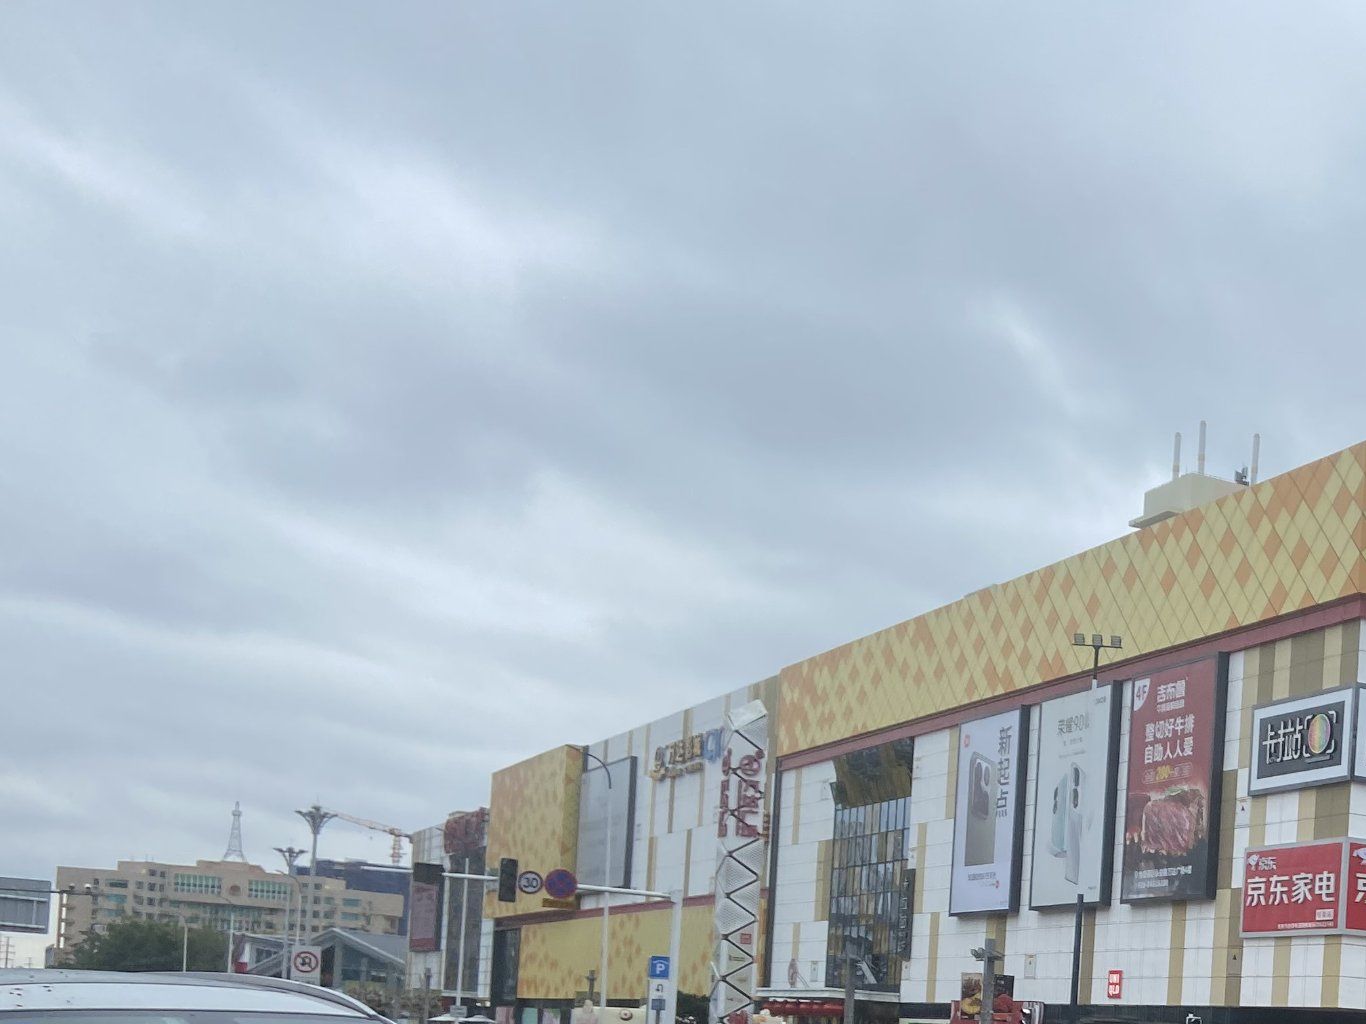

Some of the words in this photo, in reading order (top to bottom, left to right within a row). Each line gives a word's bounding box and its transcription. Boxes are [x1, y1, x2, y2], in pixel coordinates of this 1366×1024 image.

[1136, 684, 1147, 701] 4F
[1145, 737, 1193, 764] 自助人人爱
[997, 725, 1012, 818] 新起点
[1258, 856, 1276, 870] 京东
[523, 877, 538, 888] 30
[1246, 870, 1335, 907] 京东家电
